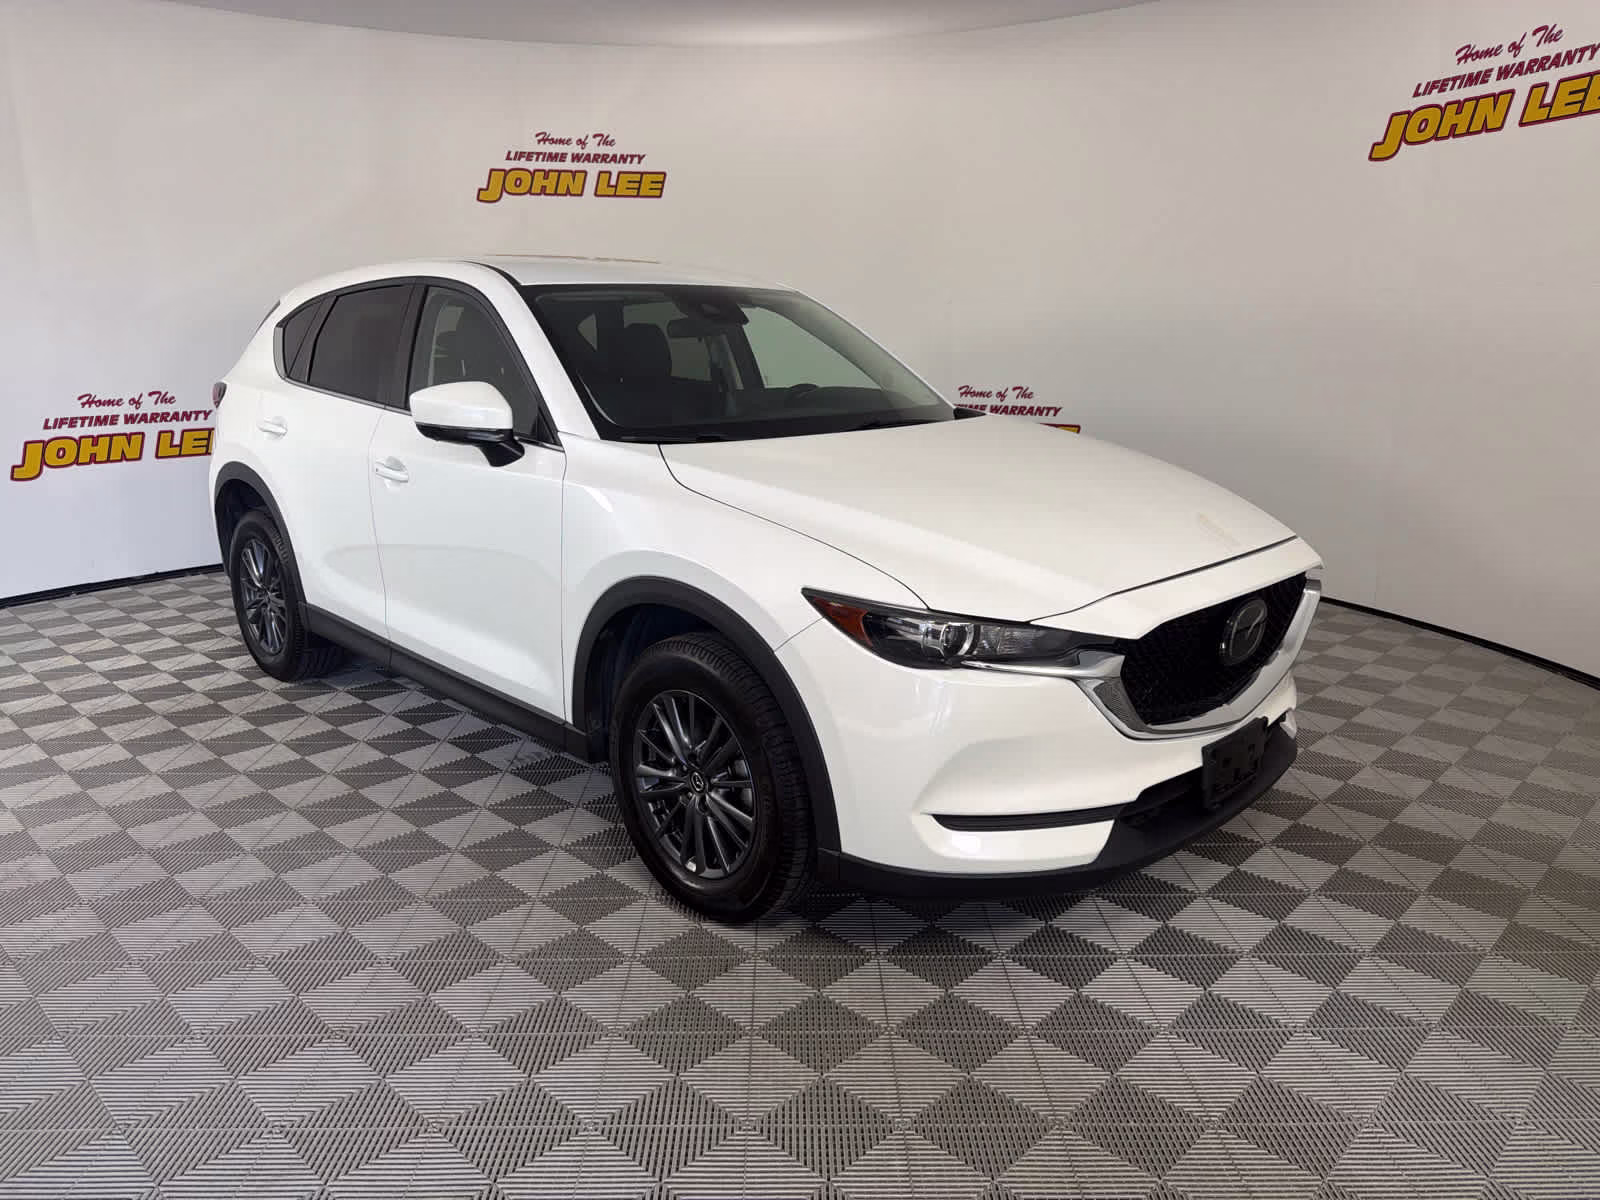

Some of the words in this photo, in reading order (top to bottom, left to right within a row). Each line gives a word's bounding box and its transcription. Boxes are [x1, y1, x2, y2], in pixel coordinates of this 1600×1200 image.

[1455, 44, 1503, 65] Home
[1508, 32, 1527, 58] of
[1532, 24, 1563, 47] The
[1412, 68, 1494, 98] LIFETIME
[1496, 43, 1600, 81] WARRANTY
[1368, 89, 1516, 162] JOHN
[535, 131, 573, 146] Home
[576, 134, 589, 149] of
[592, 133, 616, 147] The
[505, 151, 568, 163] LIFETIME
[571, 153, 646, 165] WARRANTY
[477, 168, 588, 203] JOHN
[594, 170, 667, 198] LEE
[77, 393, 125, 409] Home
[128, 393, 143, 410] of
[148, 391, 176, 406] The
[958, 385, 993, 399] Home
[995, 388, 1008, 402] of
[1012, 386, 1034, 399] The
[43, 414, 120, 430] LIFETIME
[123, 409, 213, 425] WARRANTY
[989, 404, 1063, 417] WARRANTY
[10, 432, 145, 481] JOHN
[155, 427, 215, 459] LE
